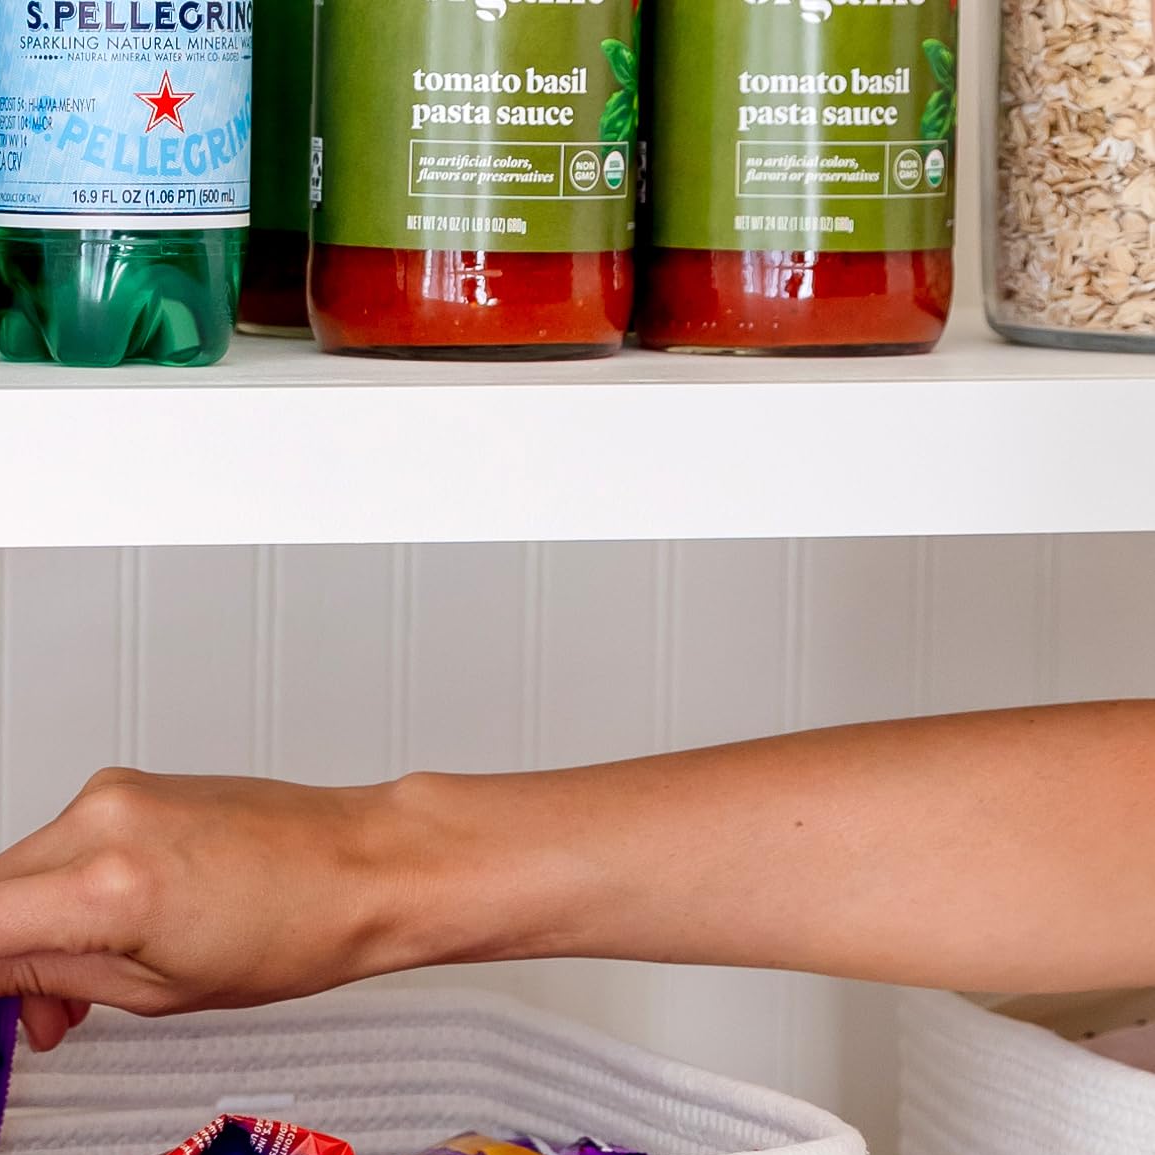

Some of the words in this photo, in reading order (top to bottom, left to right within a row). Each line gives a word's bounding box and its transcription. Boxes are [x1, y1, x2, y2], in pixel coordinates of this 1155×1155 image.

[20, 36, 99, 50] SPARKLING
[107, 36, 181, 50] NATURAL
[187, 36, 238, 50] MINERAL
[67, 52, 106, 61] NATURAL
[111, 52, 150, 61] MINERAL
[155, 52, 182, 62] WATER
[185, 52, 205, 62] WITH
[413, 69, 521, 94] tomato
[525, 67, 587, 94] basil
[738, 71, 847, 95] tomato
[851, 68, 910, 95] basil
[411, 102, 491, 129] pasta
[497, 106, 573, 126] sauce
[737, 104, 817, 131] pasta
[822, 106, 898, 126] sauce
[419, 156, 435, 166] no
[436, 155, 492, 169] artificial
[493, 156, 533, 170] colors,
[575, 161, 595, 170] NON
[746, 157, 763, 167] no
[764, 155, 818, 170] artificial
[819, 155, 859, 170] colors,
[416, 168, 461, 183] flavors
[462, 171, 477, 180] or
[477, 170, 554, 184] preservatives
[575, 171, 595, 180] GMO
[744, 168, 787, 184] flavors
[789, 172, 804, 180] or
[804, 170, 880, 185] preservatives
[72, 190, 98, 203] 16.9
[102, 190, 117, 203] FL
[122, 190, 141, 203] OZ
[145, 190, 174, 206] (1.06
[178, 190, 195, 206] PT)
[199, 189, 218, 206] (500
[407, 215, 422, 230] NET
[423, 215, 435, 230] WT
[449, 216, 461, 231] OZ
